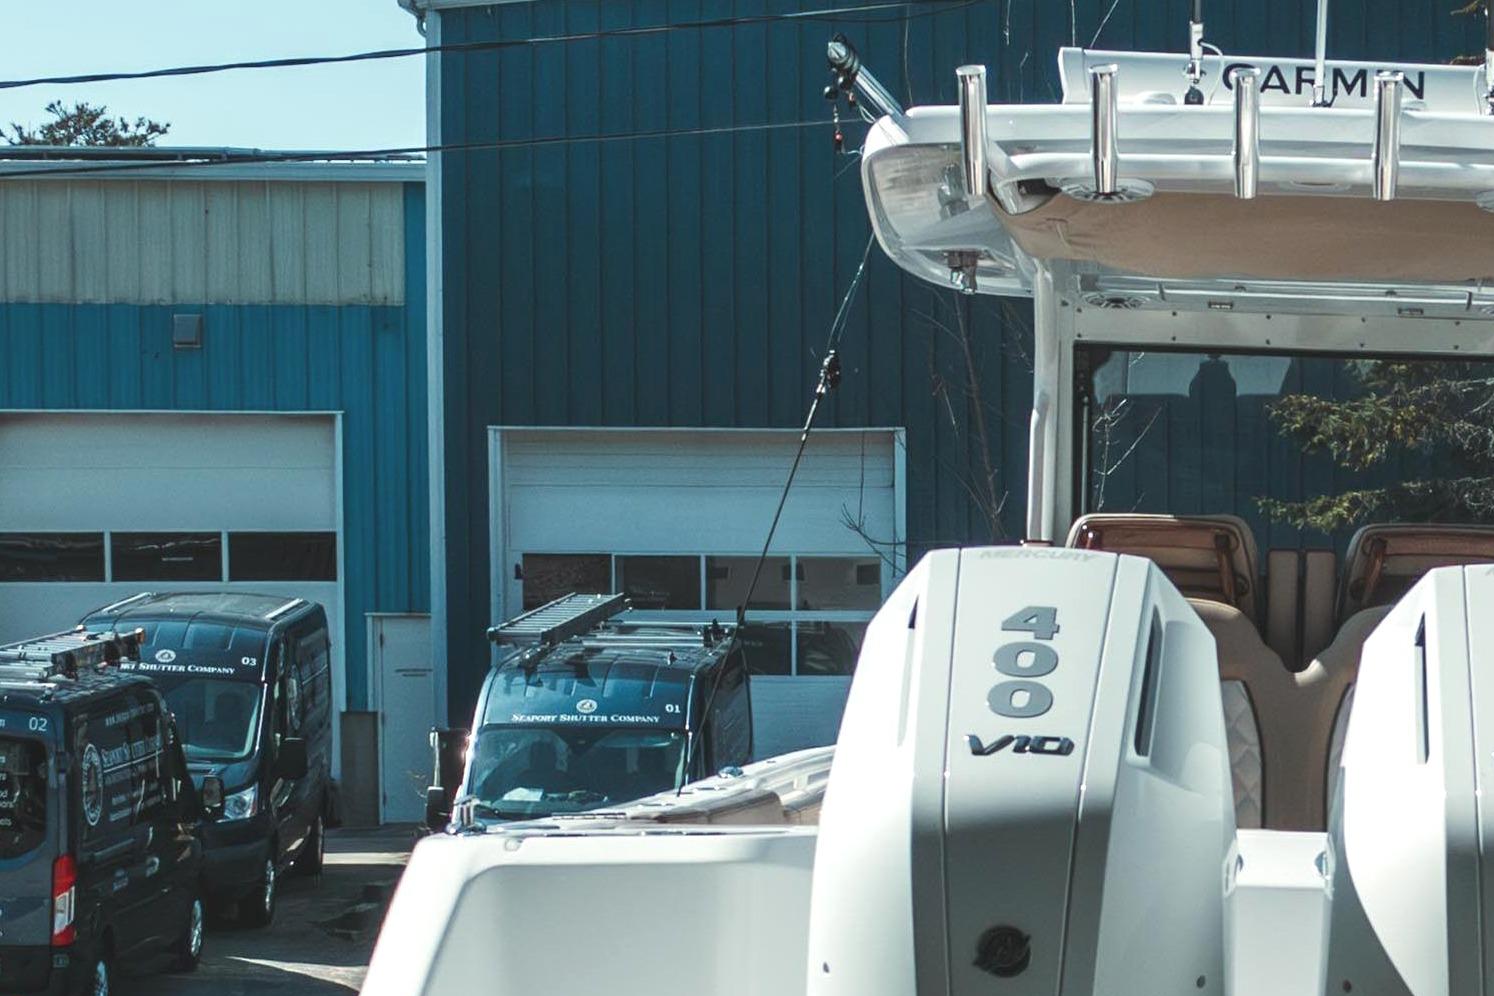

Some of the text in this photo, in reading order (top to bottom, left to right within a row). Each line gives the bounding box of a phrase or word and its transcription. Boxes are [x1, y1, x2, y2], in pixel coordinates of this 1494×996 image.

[1222, 63, 1424, 99] GARMN
[980, 549, 1099, 562] MERCURY
[241, 656, 257, 666] 03
[987, 606, 1060, 719] 400
[138, 662, 185, 672] SHUTTER
[187, 664, 236, 675] COMPANY
[665, 704, 680, 713] 01
[28, 717, 48, 731] 02
[559, 714, 608, 723] SHUTTER
[611, 714, 660, 723] COMPANY
[963, 734, 1075, 756] V10
